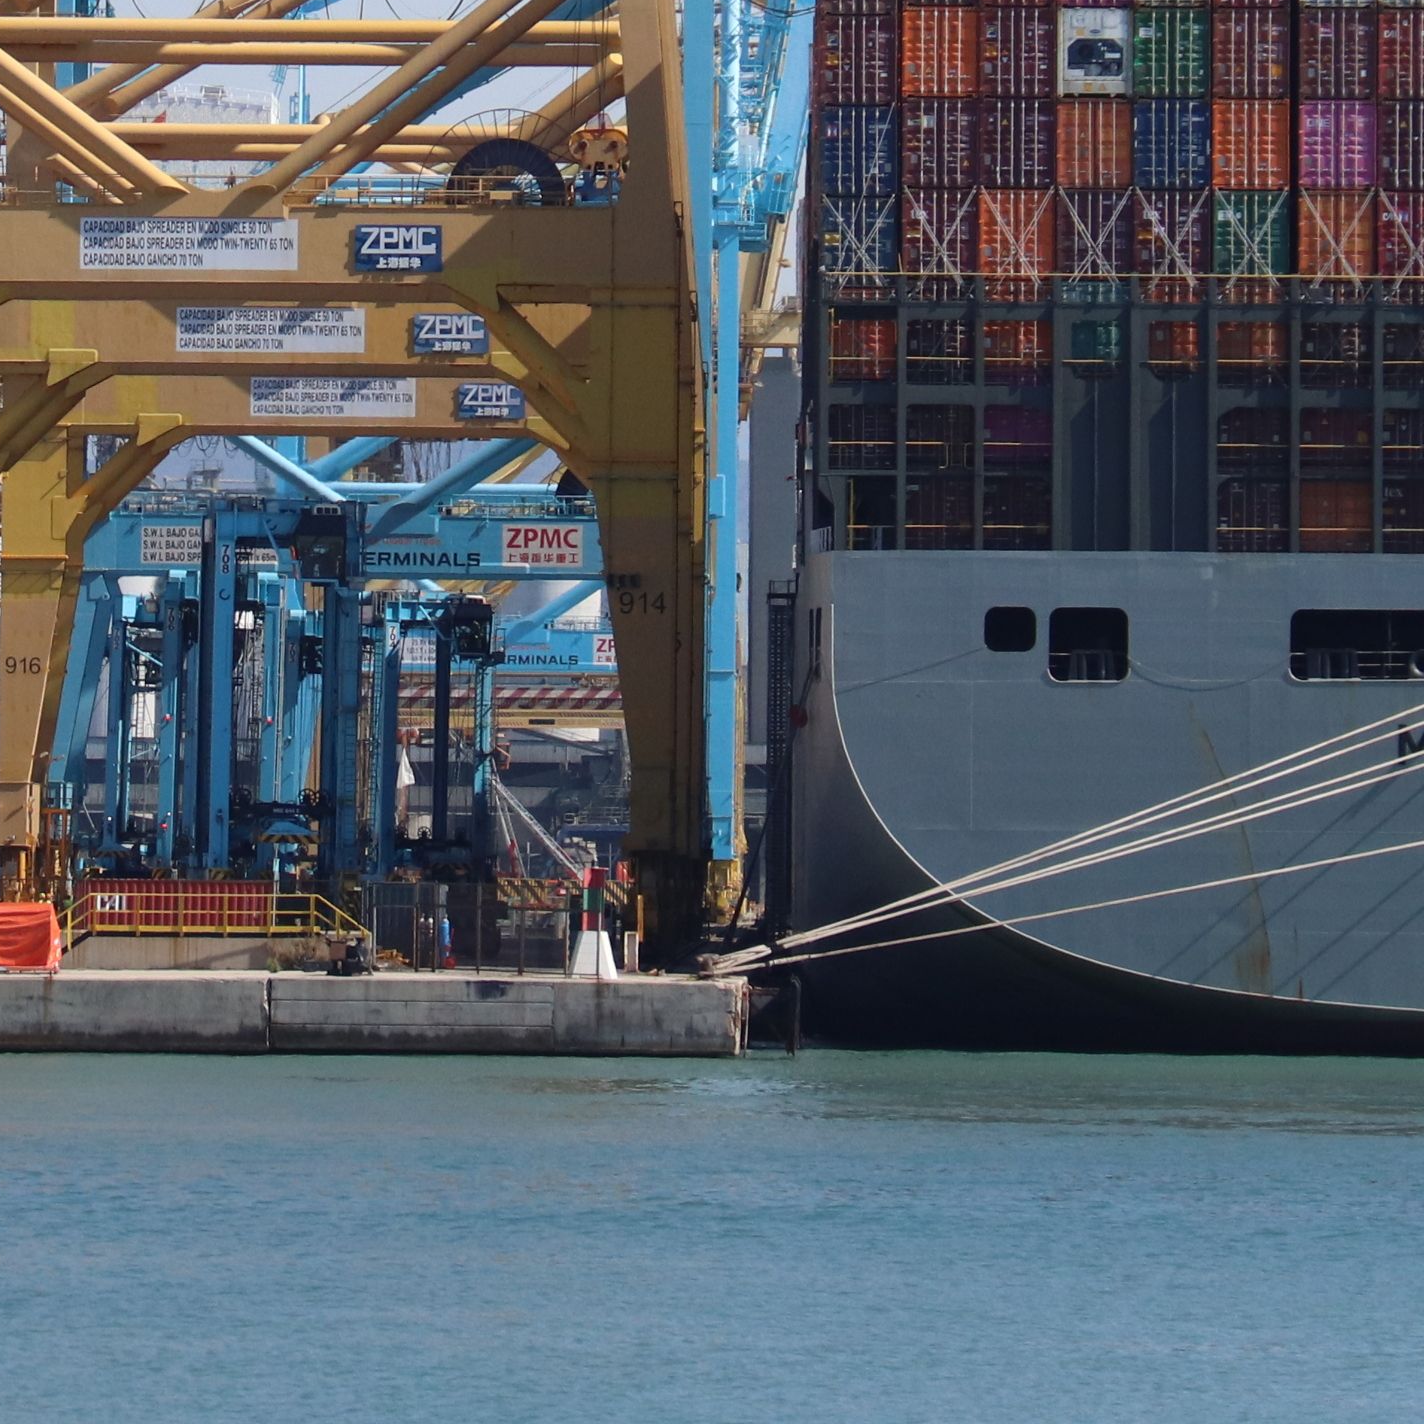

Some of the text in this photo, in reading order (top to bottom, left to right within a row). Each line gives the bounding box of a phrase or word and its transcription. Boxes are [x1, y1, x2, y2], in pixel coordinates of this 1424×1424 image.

[1307, 118, 1330, 127] ONE
[84, 221, 272, 233] CAPACIDAD BAJO SPREADER EN MODO SINGLE 50 TON
[84, 237, 293, 250] CAPACIDAD BAJO SPREADER EN MODO TWIN-TWENTY 65 TON
[360, 227, 437, 255] ZPMC
[84, 254, 203, 266] CAPACIDAD BAJO GANCHO 70 TON
[180, 310, 216, 322] CAPACIDAD
[217, 310, 234, 322] BAJO
[236, 310, 268, 322] SPREADER
[270, 310, 278, 322] EN
[280, 310, 297, 322] MODO
[299, 310, 321, 322] SINGLE
[331, 310, 343, 322] TON
[180, 325, 214, 336] CAPACIDAD
[217, 325, 233, 336] BAJO
[235, 325, 267, 336] SPREADER
[269, 325, 276, 336] EN
[278, 325, 296, 336] MODO
[298, 325, 339, 336] TWIN-TWENTY
[349, 325, 361, 336] TON
[418, 315, 485, 339] ZPMC
[180, 338, 215, 349] CAPACIDAD
[217, 338, 232, 349] BAJO
[235, 338, 261, 349] GANCHO
[271, 338, 283, 349] TON
[464, 385, 520, 405] ZPMC
[166, 528, 187, 537] BAJO
[506, 528, 579, 549] ZPMC
[165, 540, 185, 549] BAJO
[165, 552, 185, 562] BAJO
[221, 544, 230, 574] 708
[362, 552, 481, 567] ERMINALS
[619, 591, 667, 614] 914
[5, 656, 42, 674] 916
